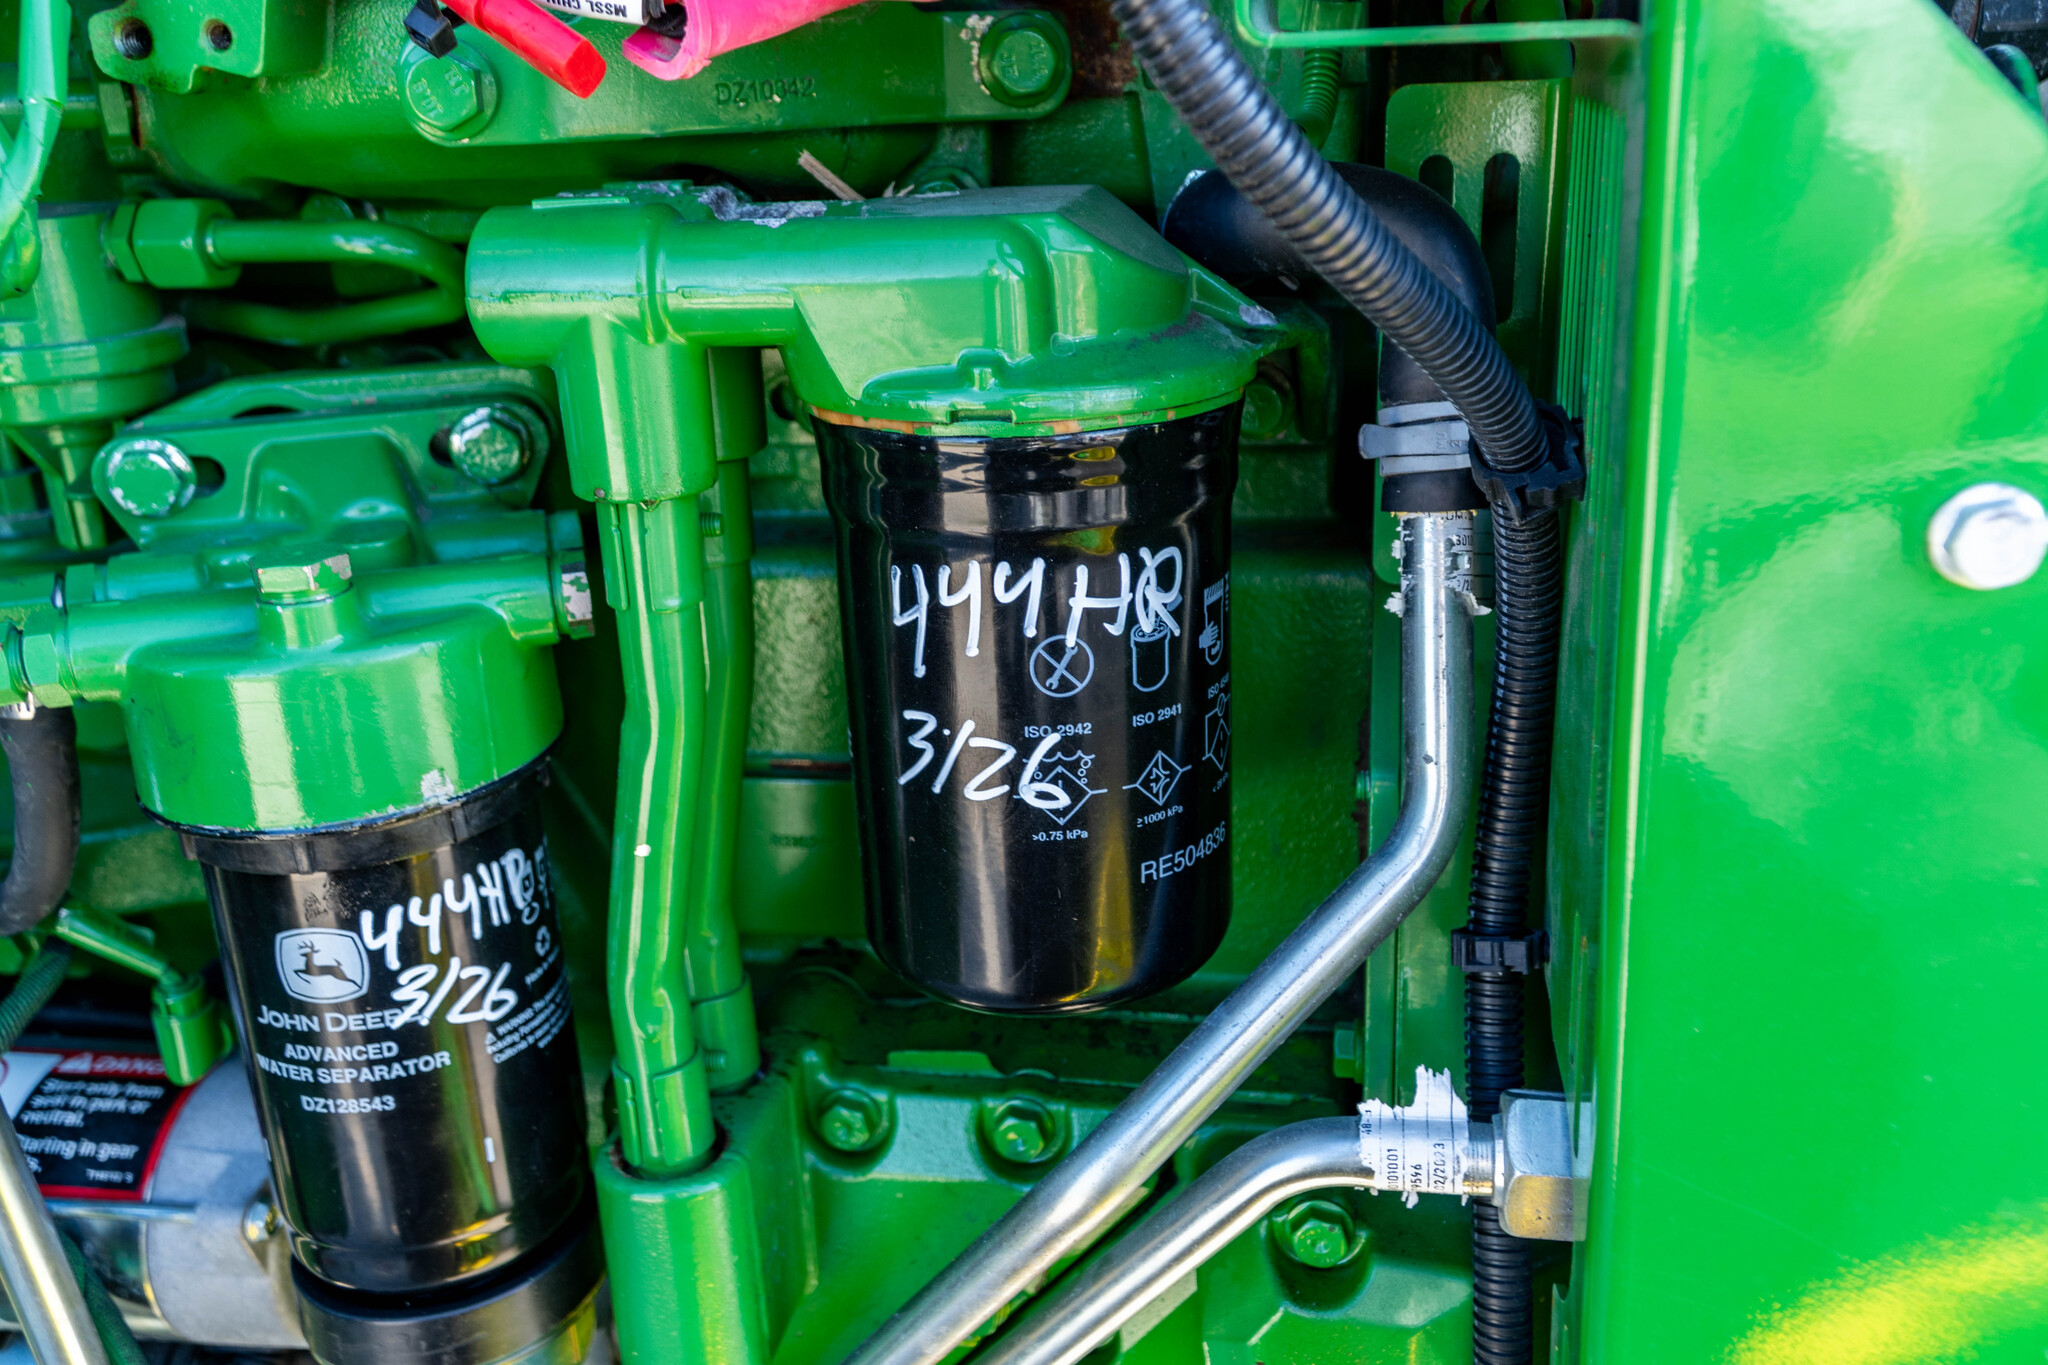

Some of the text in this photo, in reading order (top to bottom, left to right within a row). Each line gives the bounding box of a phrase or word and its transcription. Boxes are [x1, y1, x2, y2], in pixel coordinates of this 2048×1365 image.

[586, 0, 627, 18] MSSL
[1132, 702, 1182, 728] ISO 2941
[1024, 722, 1092, 739] ISO 2942
[1168, 805, 1184, 818] kPa
[1032, 829, 1089, 842] >0.75 kPa
[1140, 820, 1227, 884] RE504836
[390, 956, 519, 1031] 3/26
[257, 1004, 320, 1032] JOHN
[284, 1040, 399, 1062] ADVANCED
[256, 1050, 451, 1084] WATER SEPARATOR
[299, 1094, 397, 1114] DZ128543
[78, 1137, 97, 1158] in
[96, 1142, 140, 1162] gear
